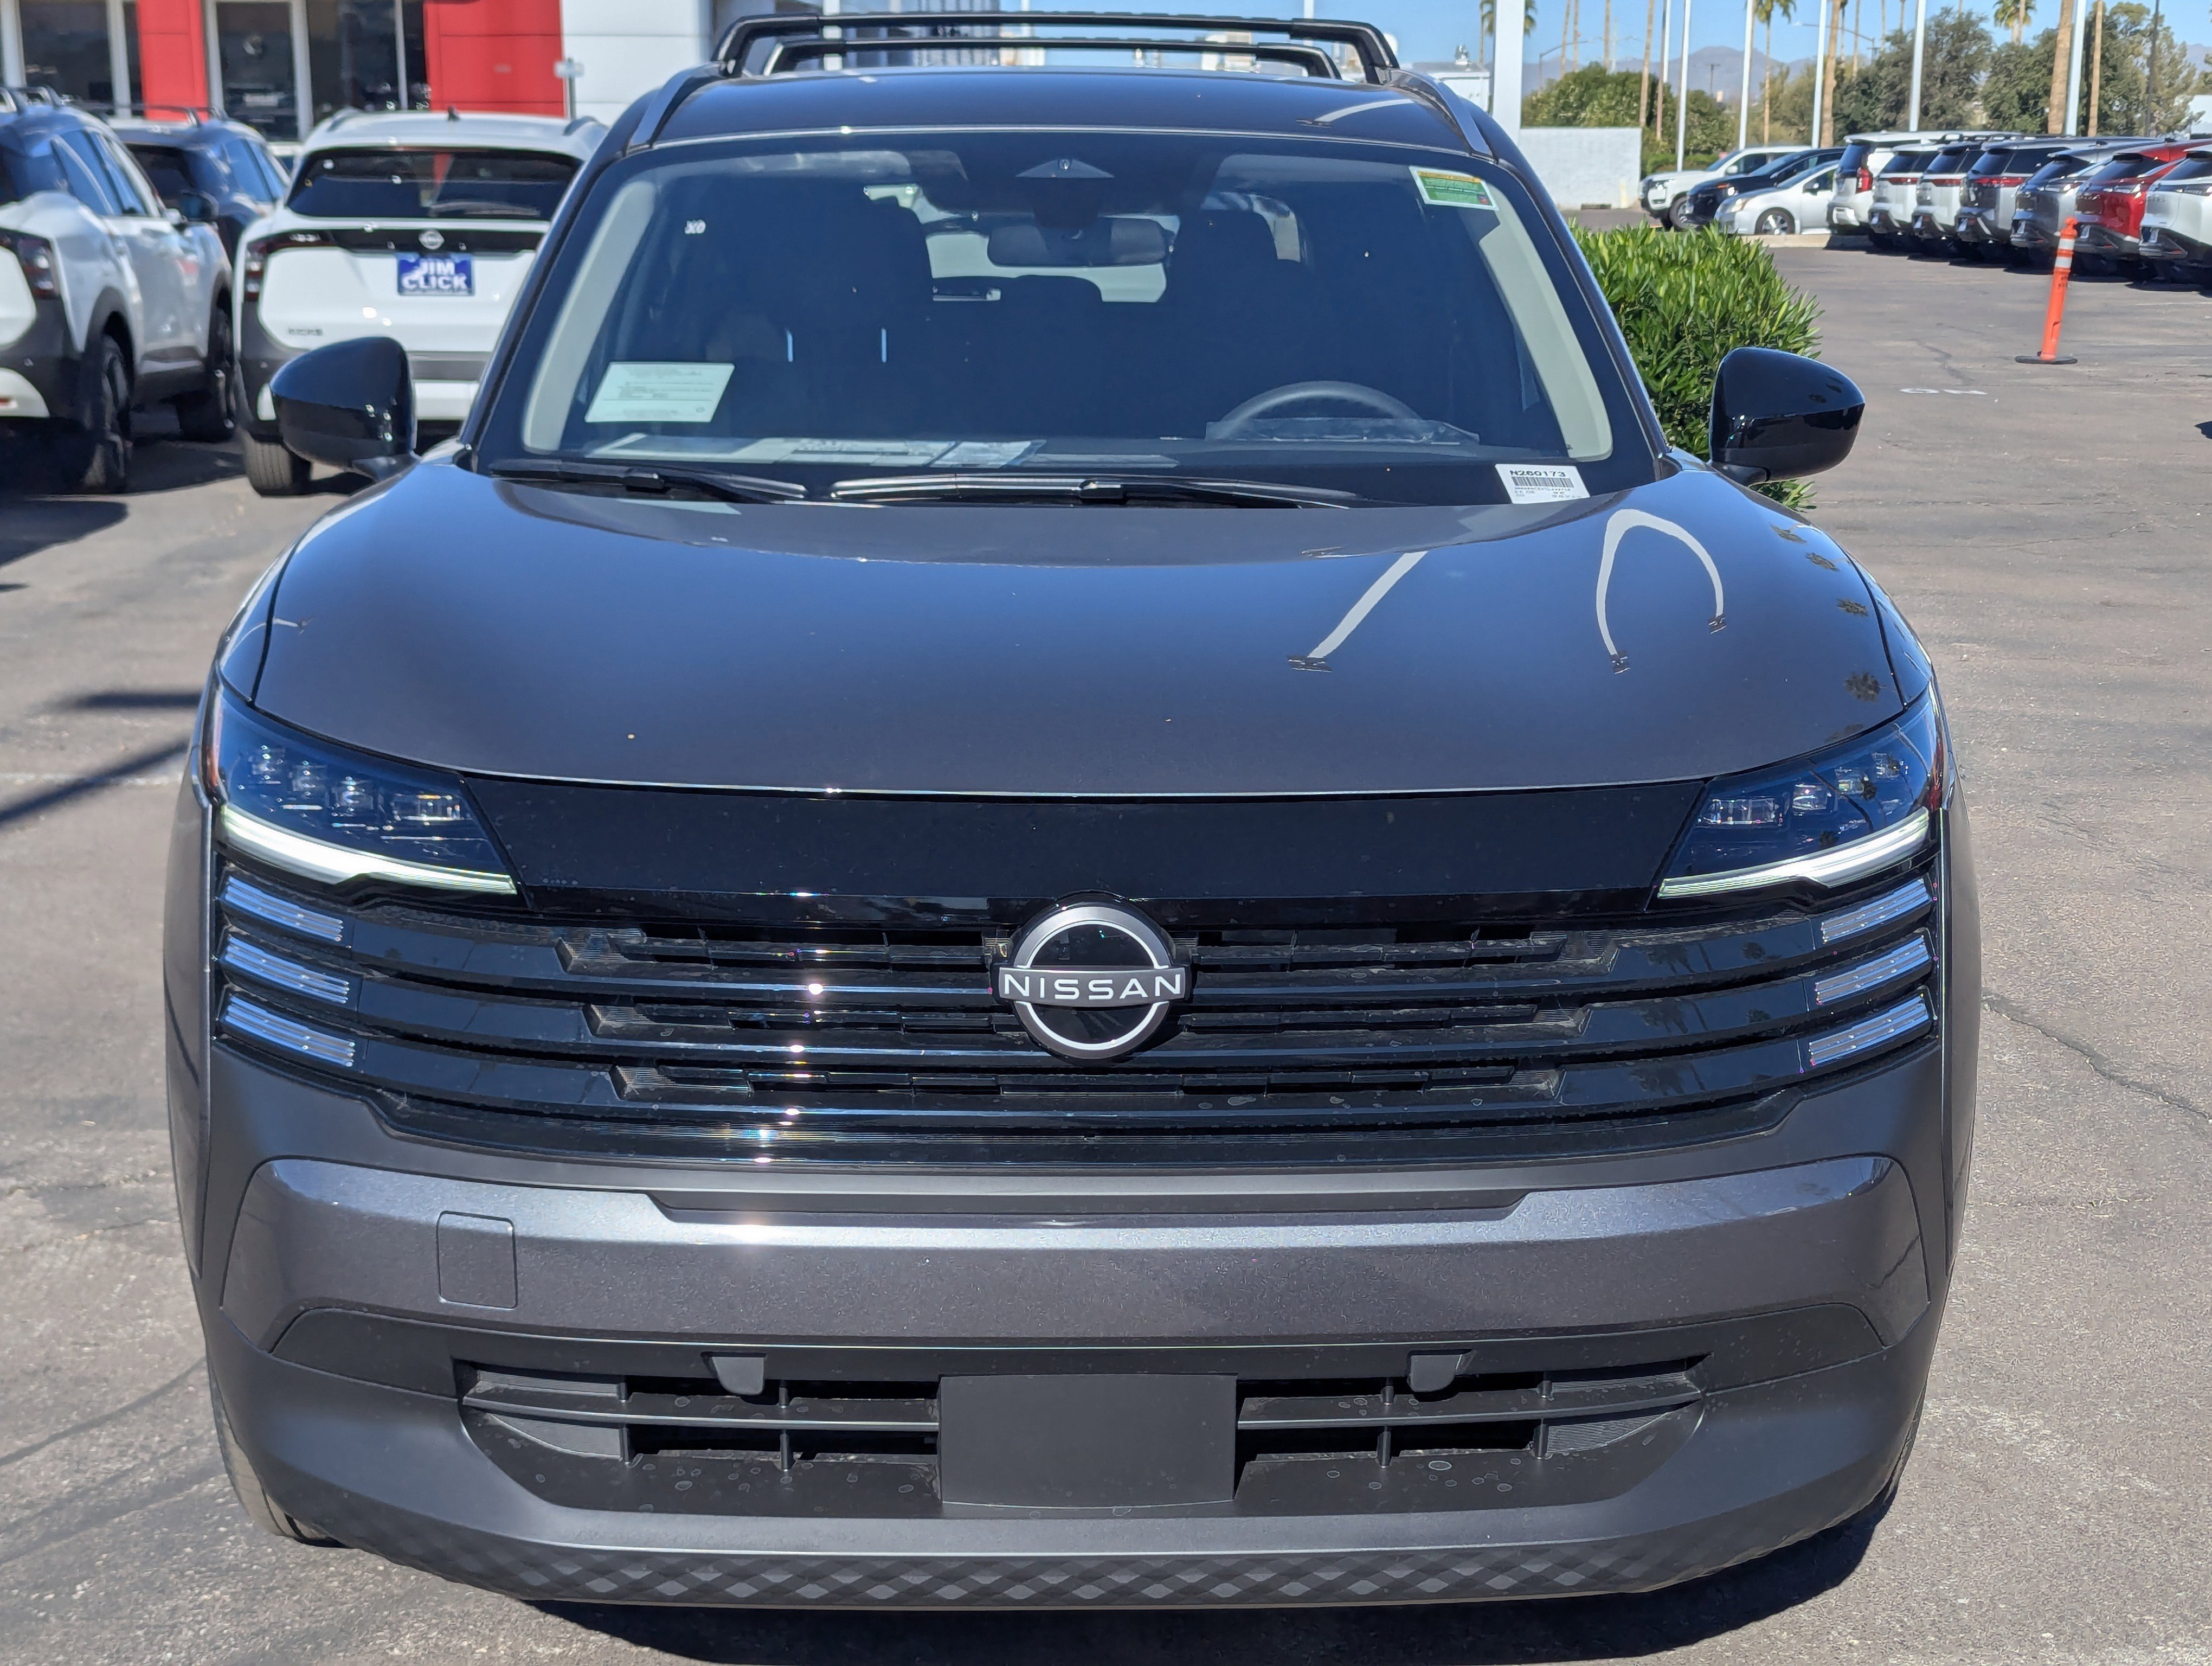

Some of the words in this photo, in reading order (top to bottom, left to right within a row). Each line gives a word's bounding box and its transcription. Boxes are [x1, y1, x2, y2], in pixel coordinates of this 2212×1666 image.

[414, 258, 455, 275] JIM
[402, 274, 467, 290] CLICK
[1004, 973, 1181, 1000] NISSAN
